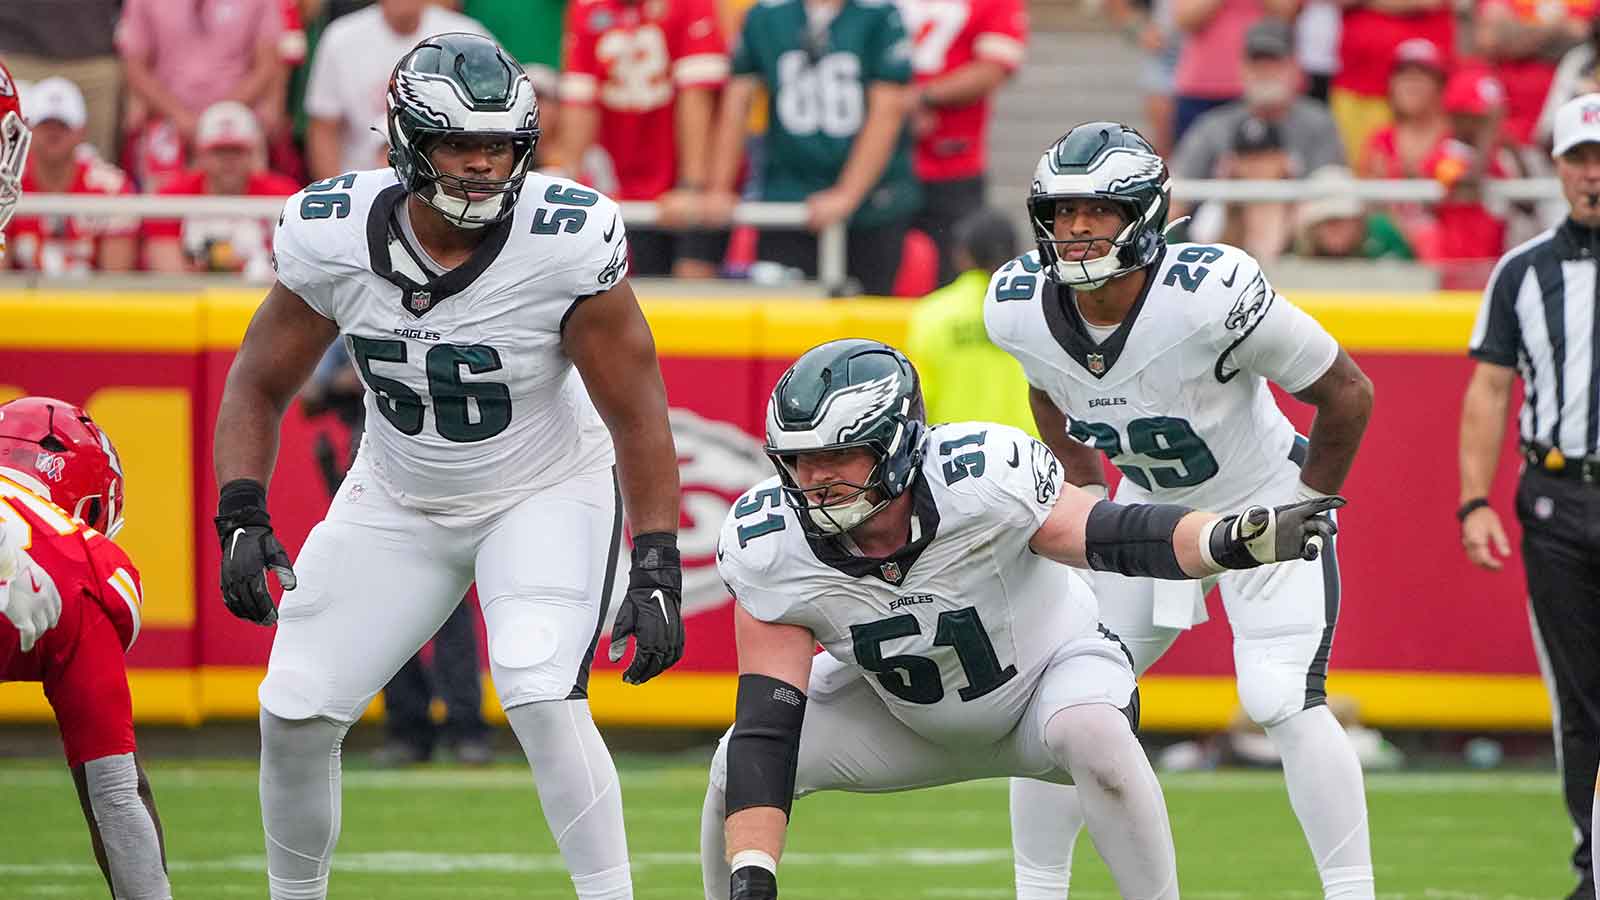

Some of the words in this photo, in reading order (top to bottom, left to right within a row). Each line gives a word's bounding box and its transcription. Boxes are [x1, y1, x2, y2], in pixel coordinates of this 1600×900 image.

[530, 184, 599, 235] 56
[1162, 247, 1224, 293] 29
[394, 328, 440, 341] EAGLES
[346, 335, 512, 442] 56
[1088, 397, 1127, 408] EAGLES
[939, 430, 987, 487] 51
[1066, 414, 1219, 492] 29
[735, 485, 786, 549] 51
[889, 594, 933, 610] EAGLES
[849, 606, 1018, 704] 51
